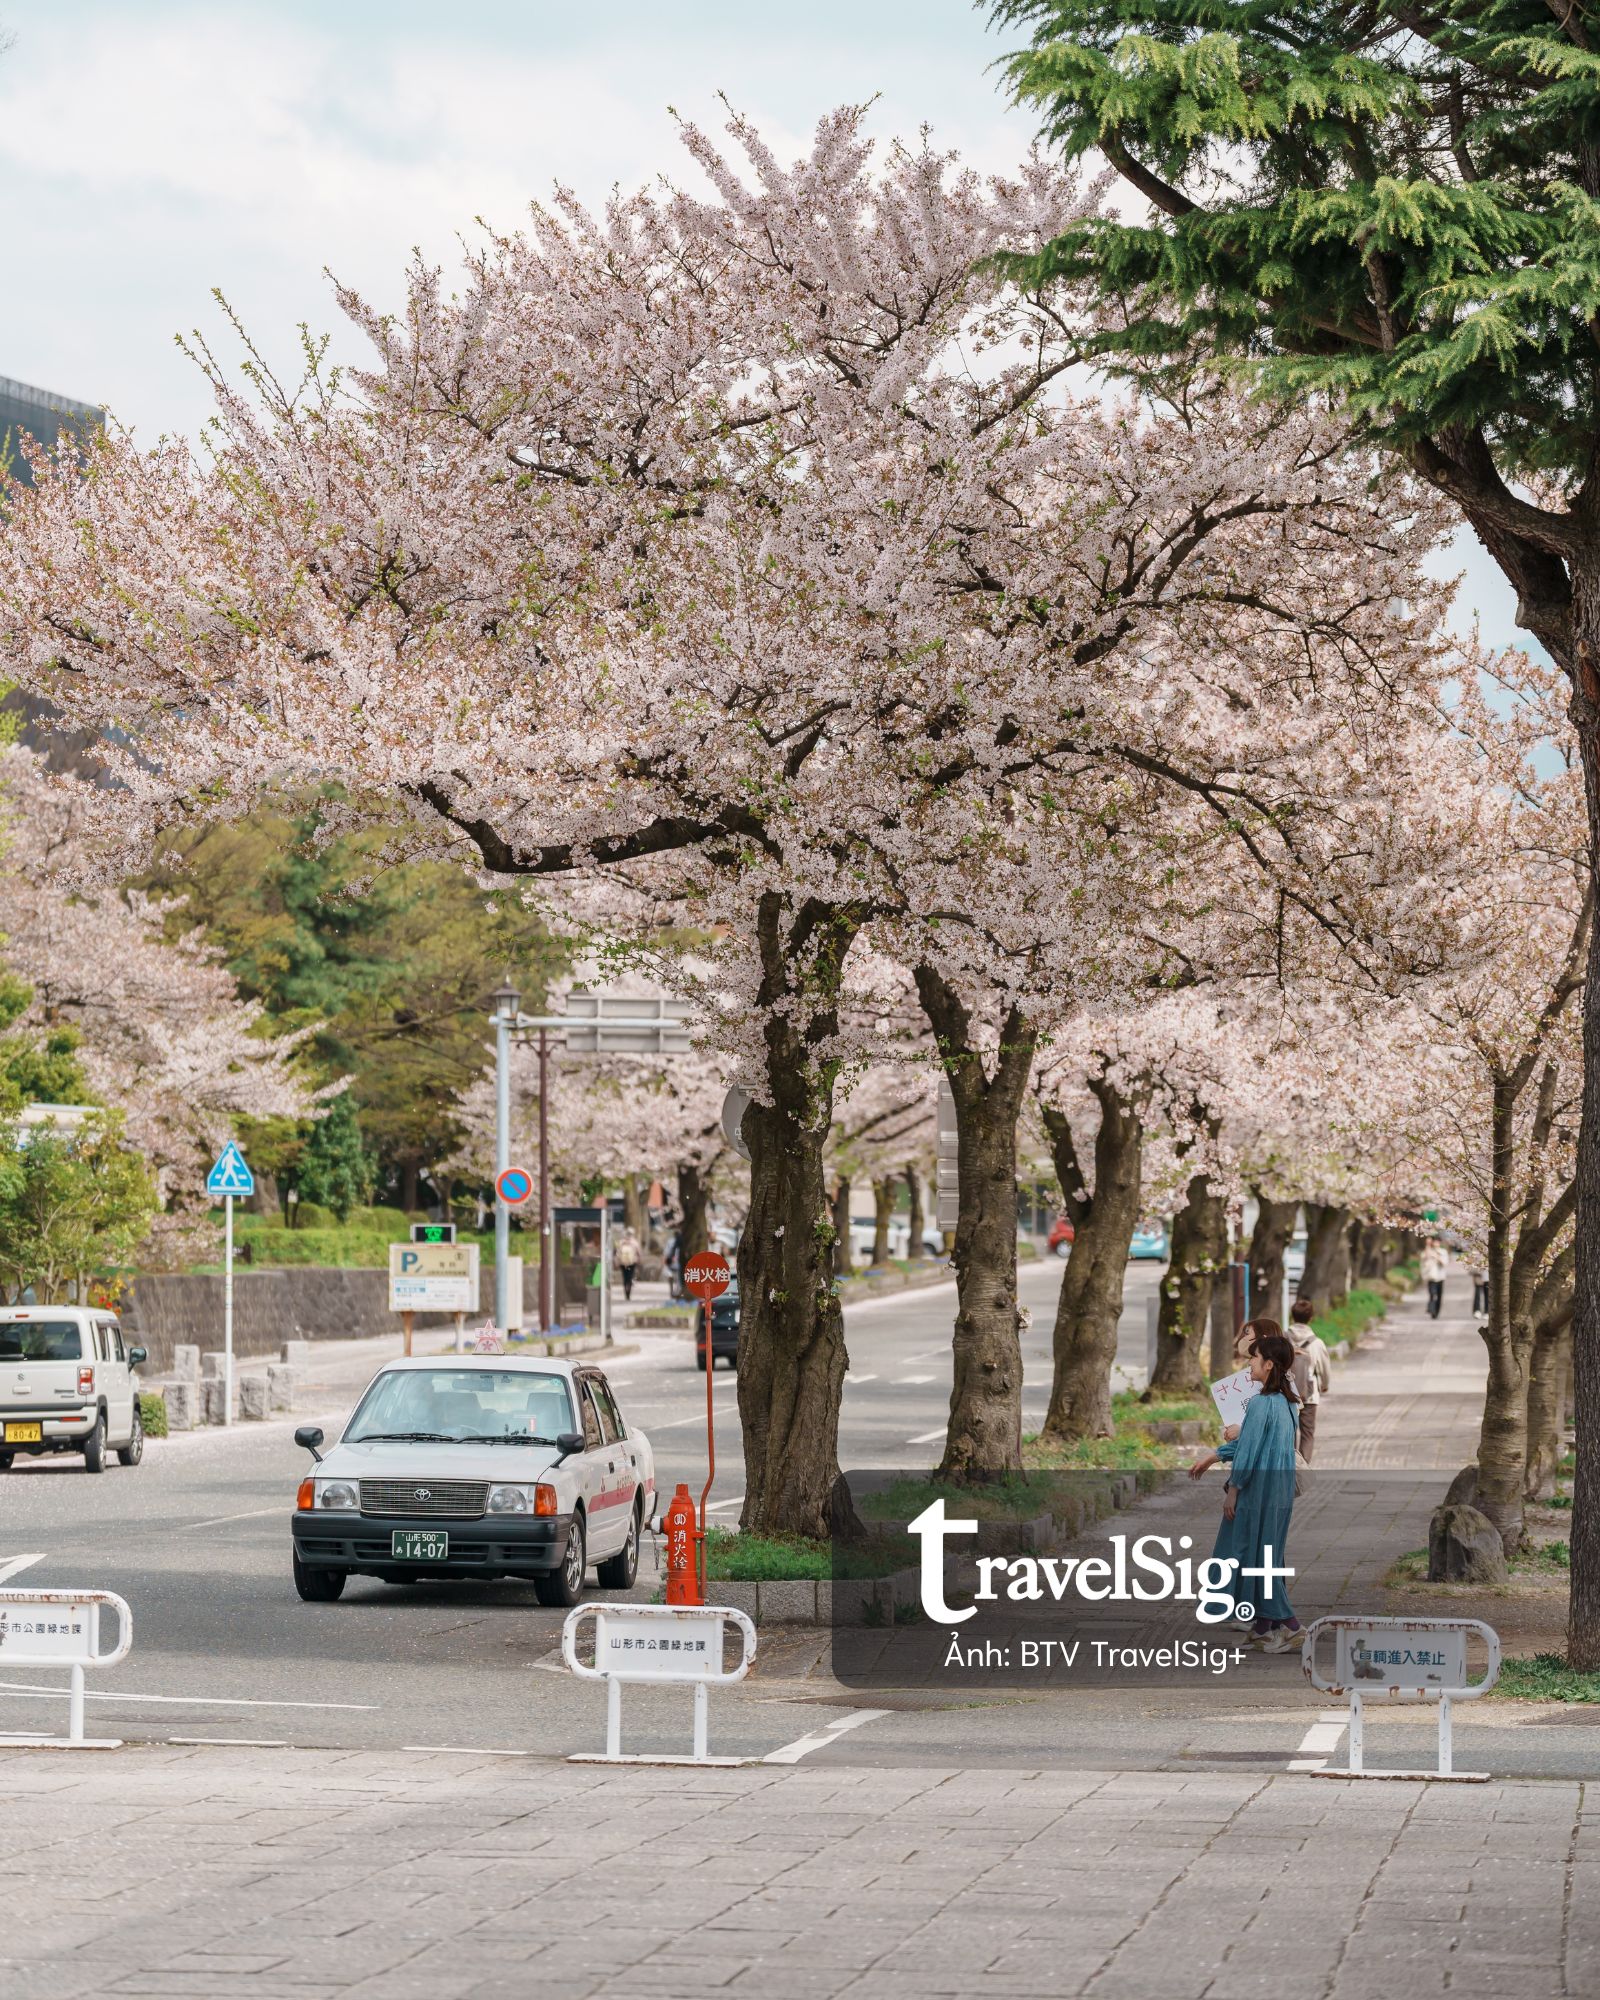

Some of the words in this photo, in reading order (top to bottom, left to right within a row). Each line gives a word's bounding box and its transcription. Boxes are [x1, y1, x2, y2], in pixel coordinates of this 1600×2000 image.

[401, 1252, 418, 1273] P
[685, 1267, 730, 1283] 消火栓
[405, 1533, 421, 1542] 山形
[422, 1534, 436, 1542] 500
[406, 1542, 445, 1558] 14-07
[673, 1530, 688, 1569] 消火栓
[610, 1638, 706, 1651] 山形市公園緑地課
